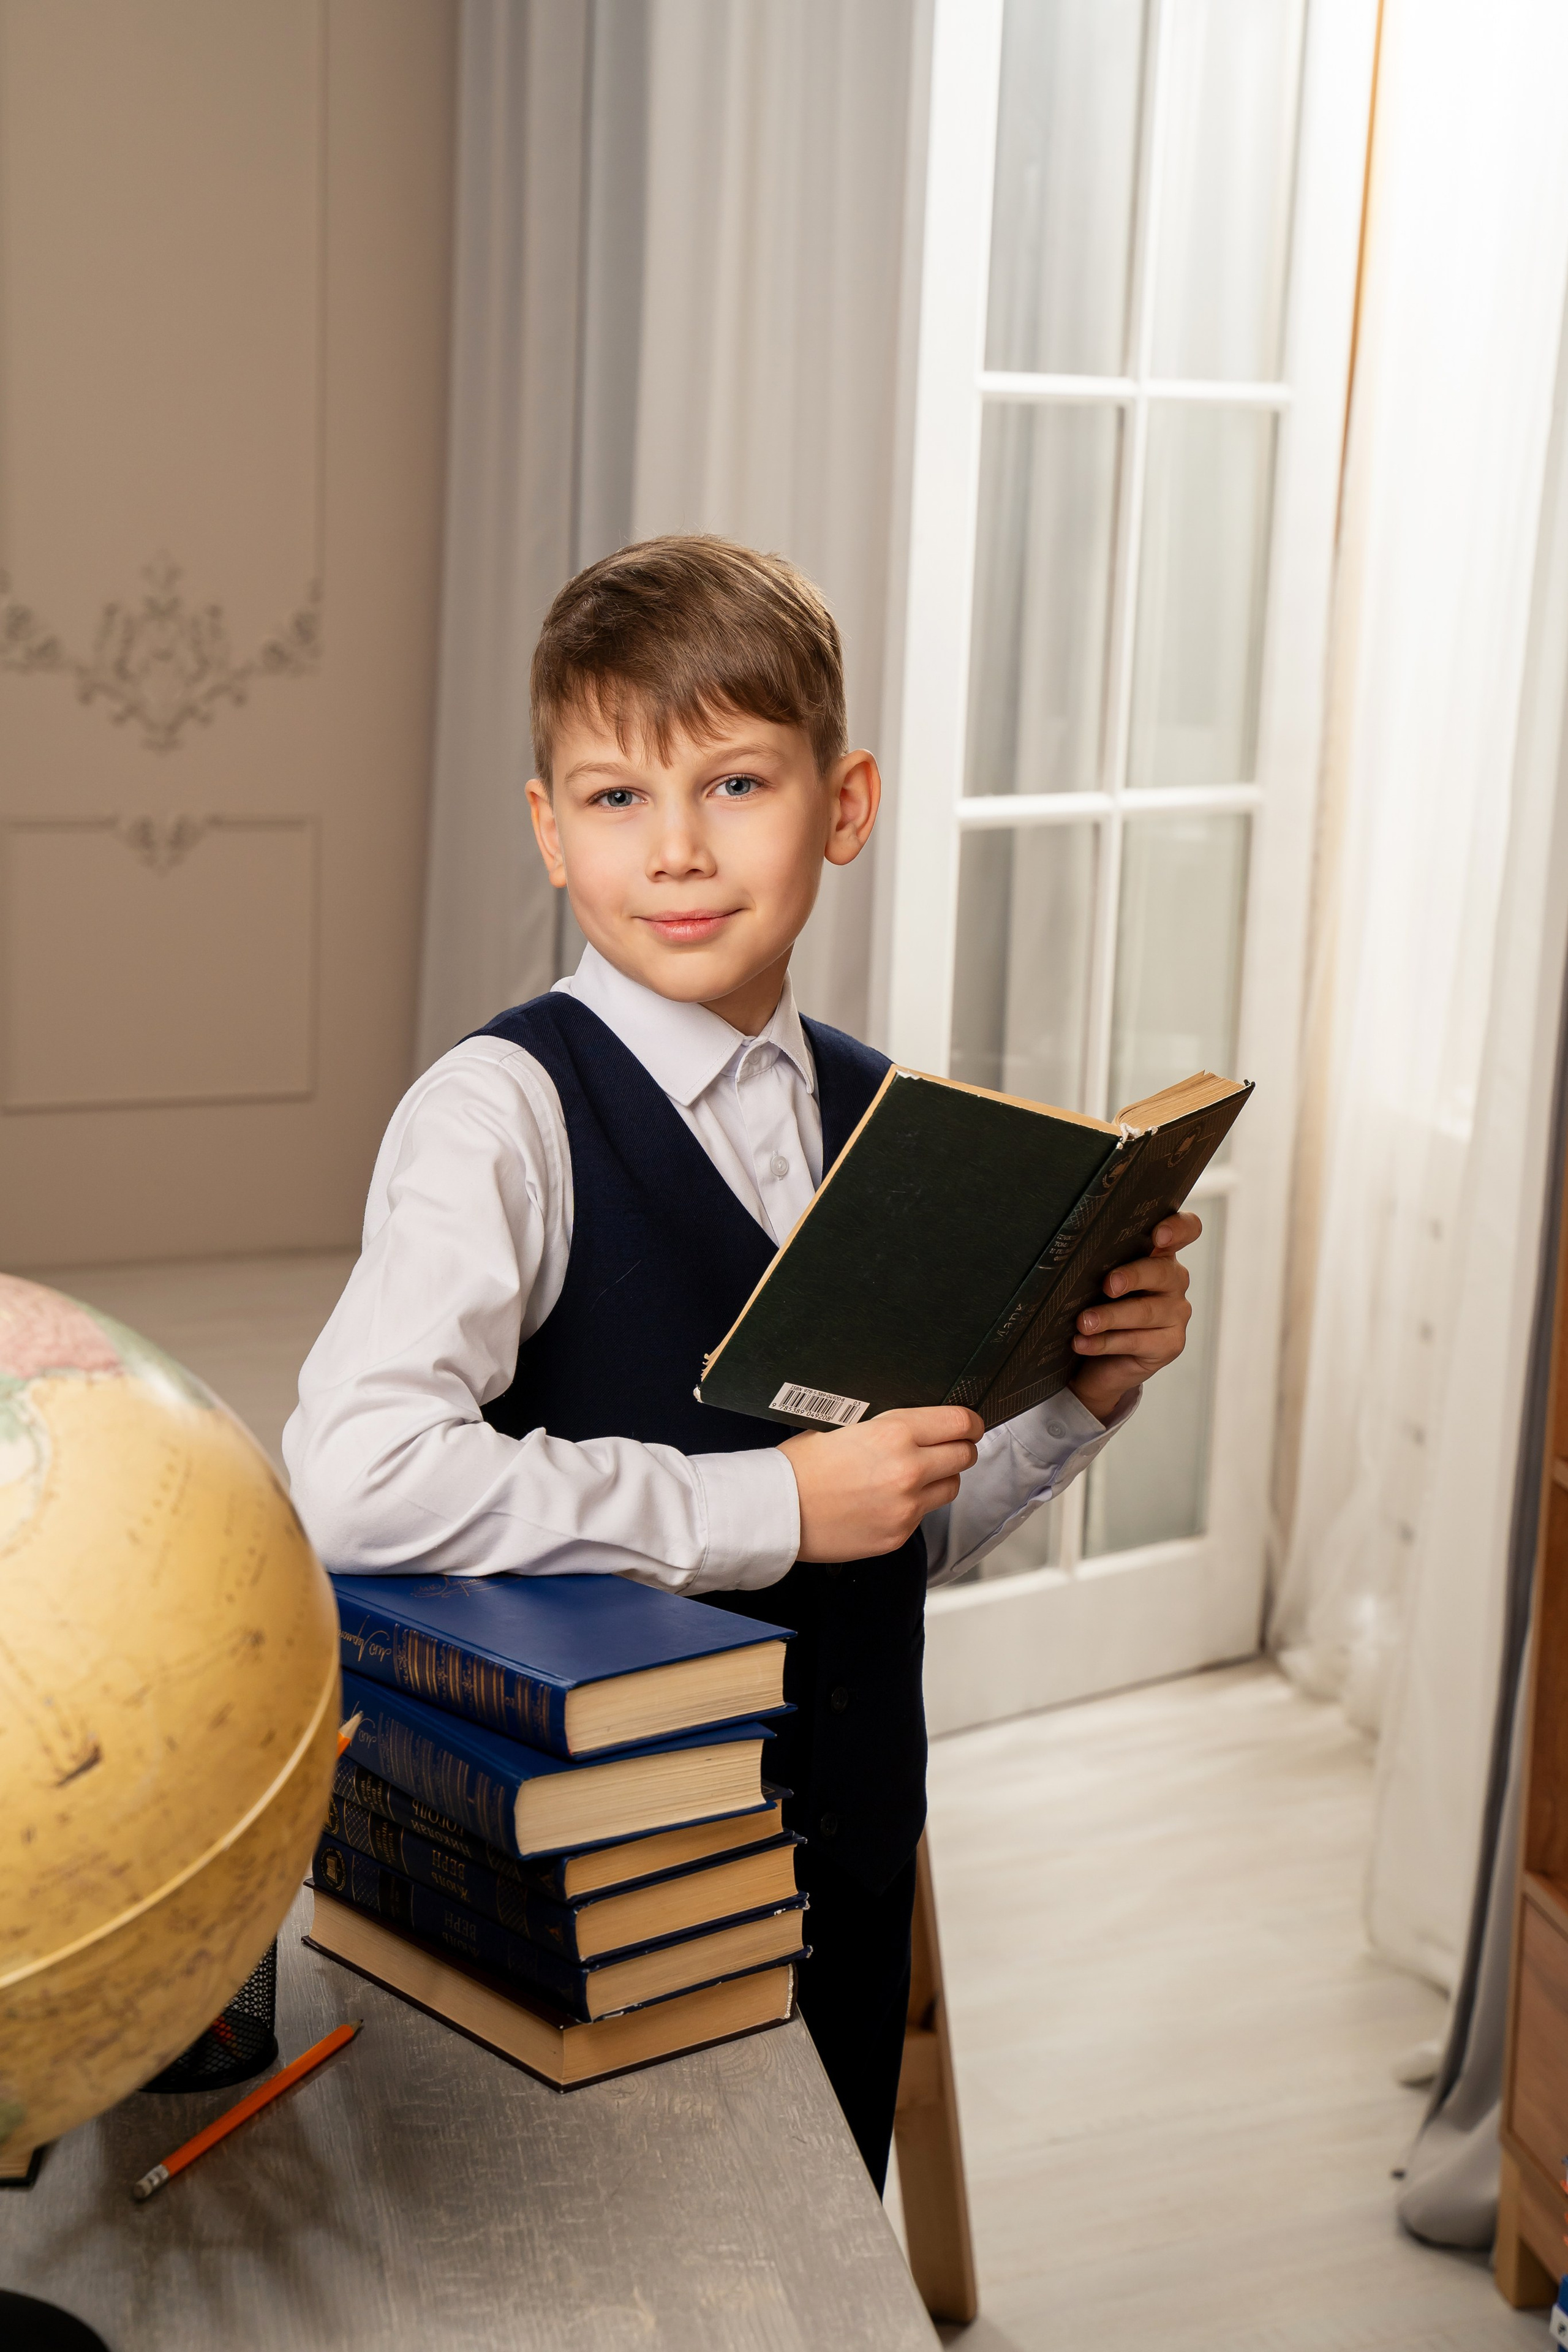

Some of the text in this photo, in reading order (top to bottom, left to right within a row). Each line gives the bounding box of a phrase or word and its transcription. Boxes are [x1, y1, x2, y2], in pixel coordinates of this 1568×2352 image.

[804, 1388, 845, 1402] 978-5-389-04920-8
[779, 1404, 805, 1414] 785389
[807, 1411, 831, 1421] 049208
[411, 1819, 472, 1858] Николай
[432, 1849, 466, 1880] ВЕРН
[431, 1871, 471, 1902] Жюль
[443, 1910, 477, 1942] ВЕРН
